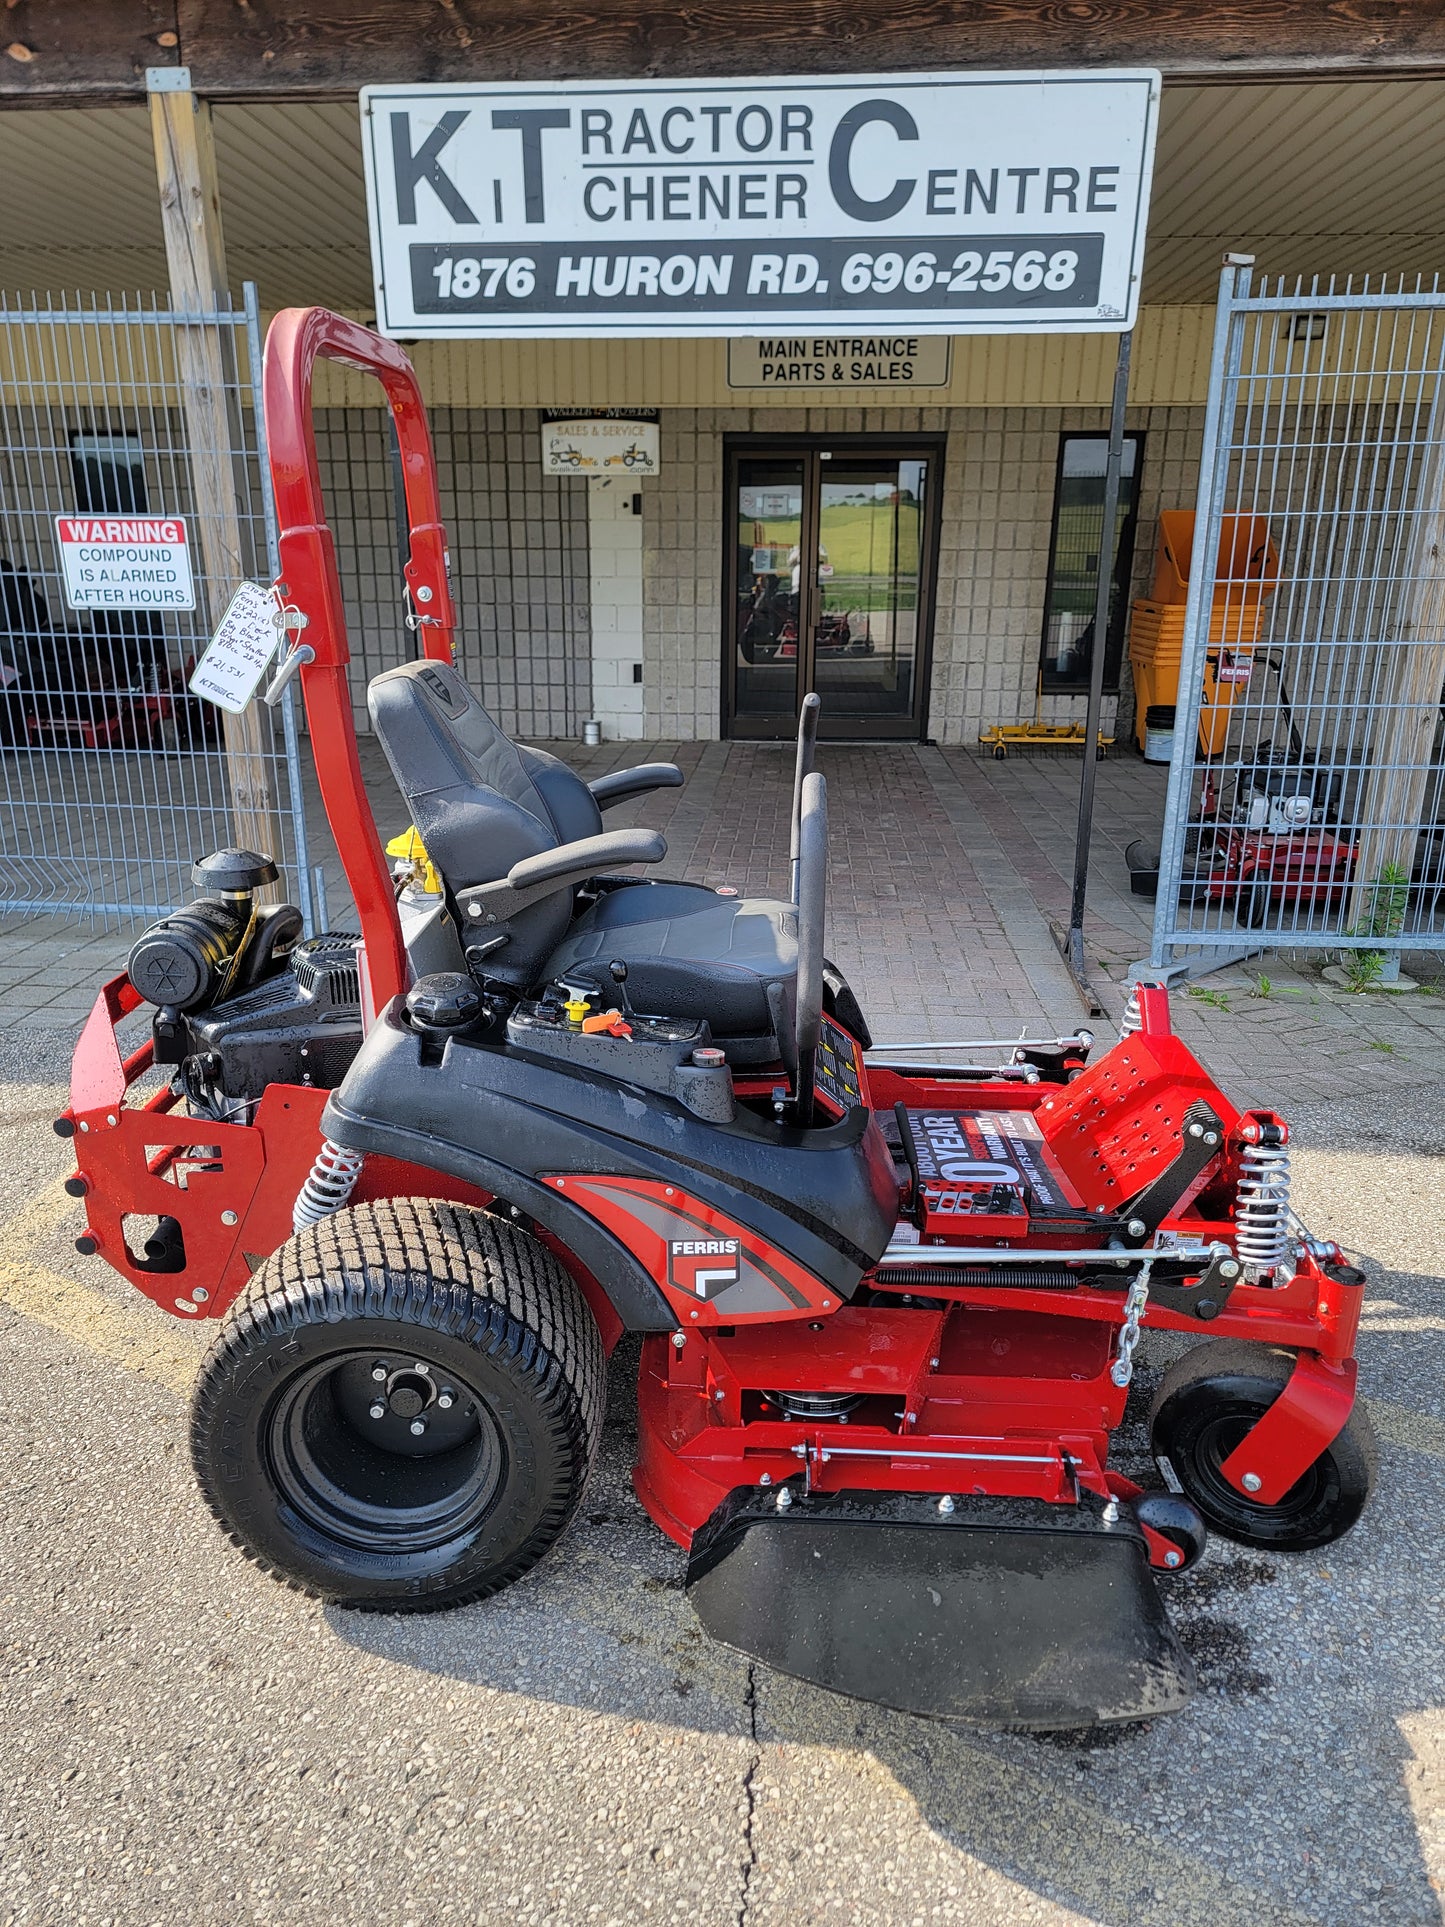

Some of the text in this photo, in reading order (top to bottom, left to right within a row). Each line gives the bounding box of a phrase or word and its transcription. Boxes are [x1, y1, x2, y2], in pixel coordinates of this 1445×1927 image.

[583, 173, 808, 223] CHENER
[432, 248, 1079, 299] 1876 HURON RD. 696-2568
[759, 338, 919, 358] MAIN ENTRANCE
[762, 362, 914, 381] PARTS & SALES
[557, 425, 589, 437] SALES
[603, 425, 646, 437] SERVICE
[66, 521, 179, 543] WARNING
[79, 548, 172, 562] COMPOUND
[80, 569, 177, 582] IS ALARMED
[74, 589, 190, 603] AFTER HOURS.
[225, 619, 262, 643] Big Block
[242, 652, 254, 662] 28
[975, 1117, 1009, 1159] WARRANTY
[1010, 1138, 1029, 1156] BUILT
[922, 1116, 1020, 1184] 0 YEAR
[1018, 1157, 1035, 1168] IT'S
[1024, 1168, 1043, 1184] THAT
[1033, 1183, 1055, 1205] PROOF
[672, 1239, 737, 1255] FERRIS
